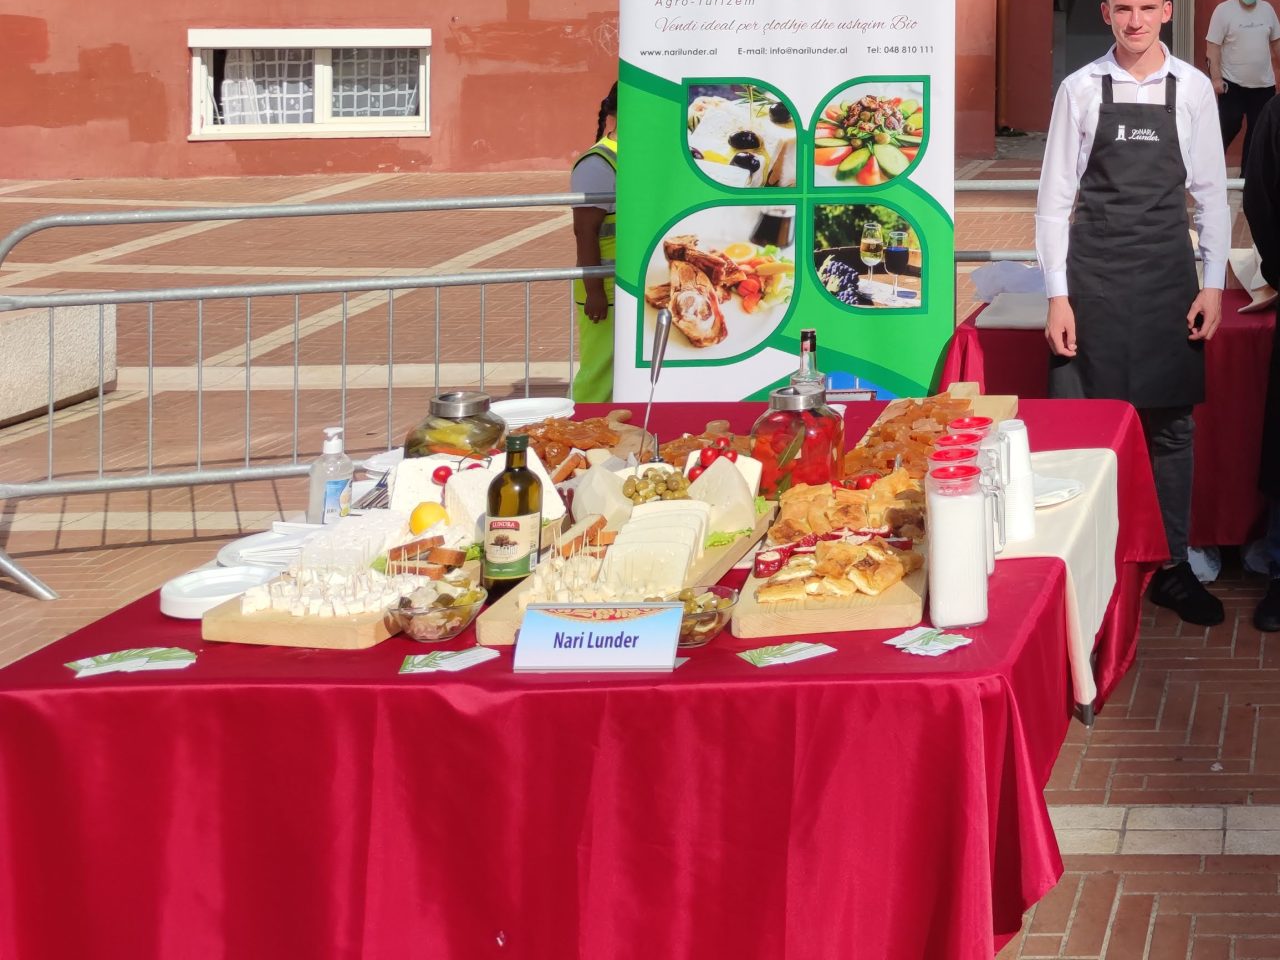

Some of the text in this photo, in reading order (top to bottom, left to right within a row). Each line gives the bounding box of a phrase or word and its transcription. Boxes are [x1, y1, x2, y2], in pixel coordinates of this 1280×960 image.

[655, 16, 698, 32] Vendi
[700, 20, 735, 31] ideal
[810, 19, 835, 30] dhe
[889, 15, 918, 30] Bio
[640, 46, 934, 56] www.narilunder.al E-mail: info@narilunder.al Tel: 048 810 111
[553, 631, 640, 649] Nari Lunder
